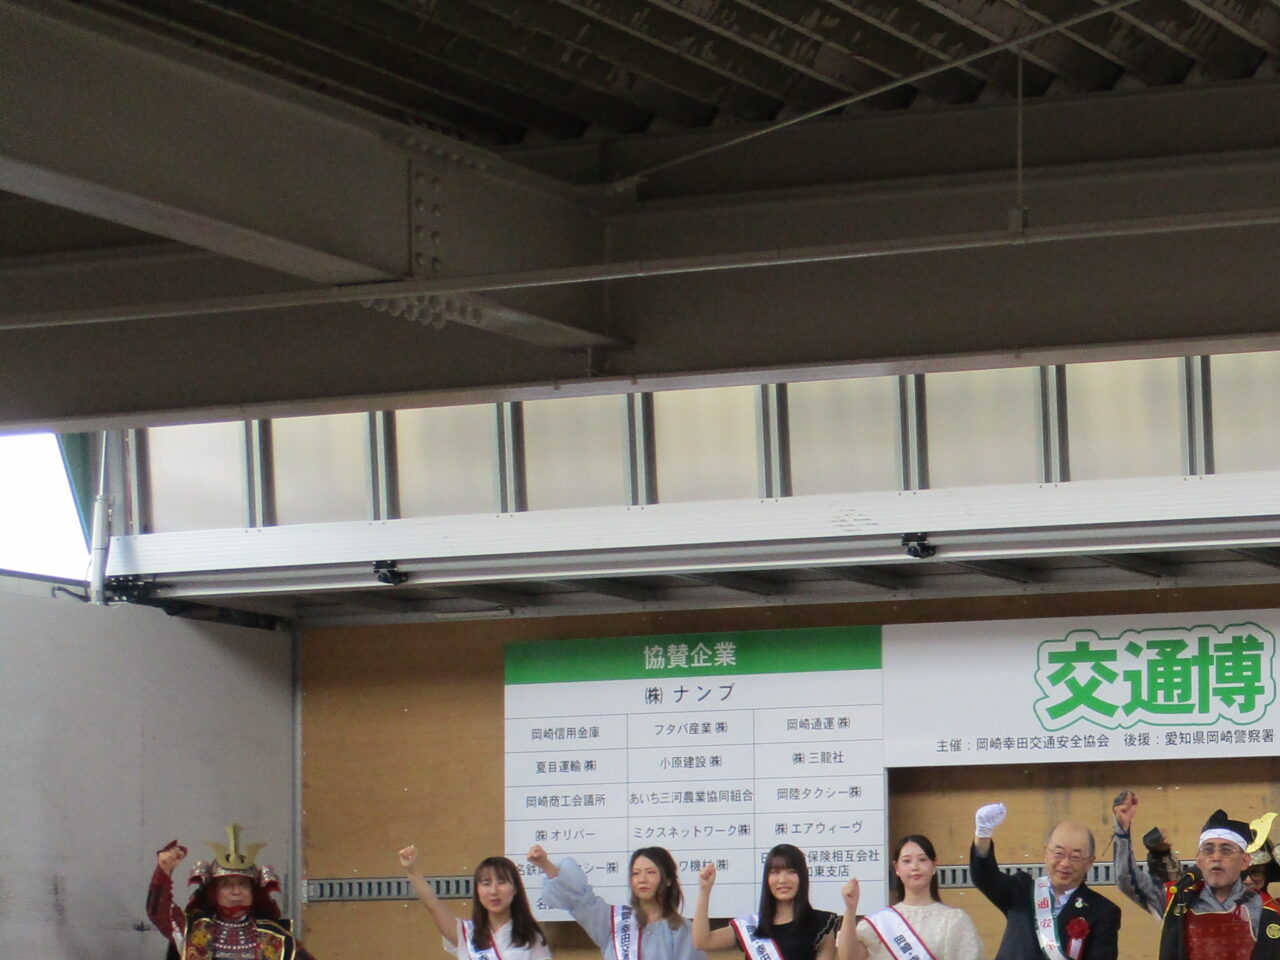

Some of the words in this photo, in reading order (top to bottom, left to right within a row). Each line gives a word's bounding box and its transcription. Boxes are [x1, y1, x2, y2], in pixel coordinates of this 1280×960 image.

[643, 641, 737, 670] 協賛企業
[1046, 633, 1266, 721] 交通博
[531, 726, 600, 741] 岡崎信用金庫
[526, 793, 606, 809] 岡崎商工会議所
[629, 788, 753, 805] あいち三河農業協同組合
